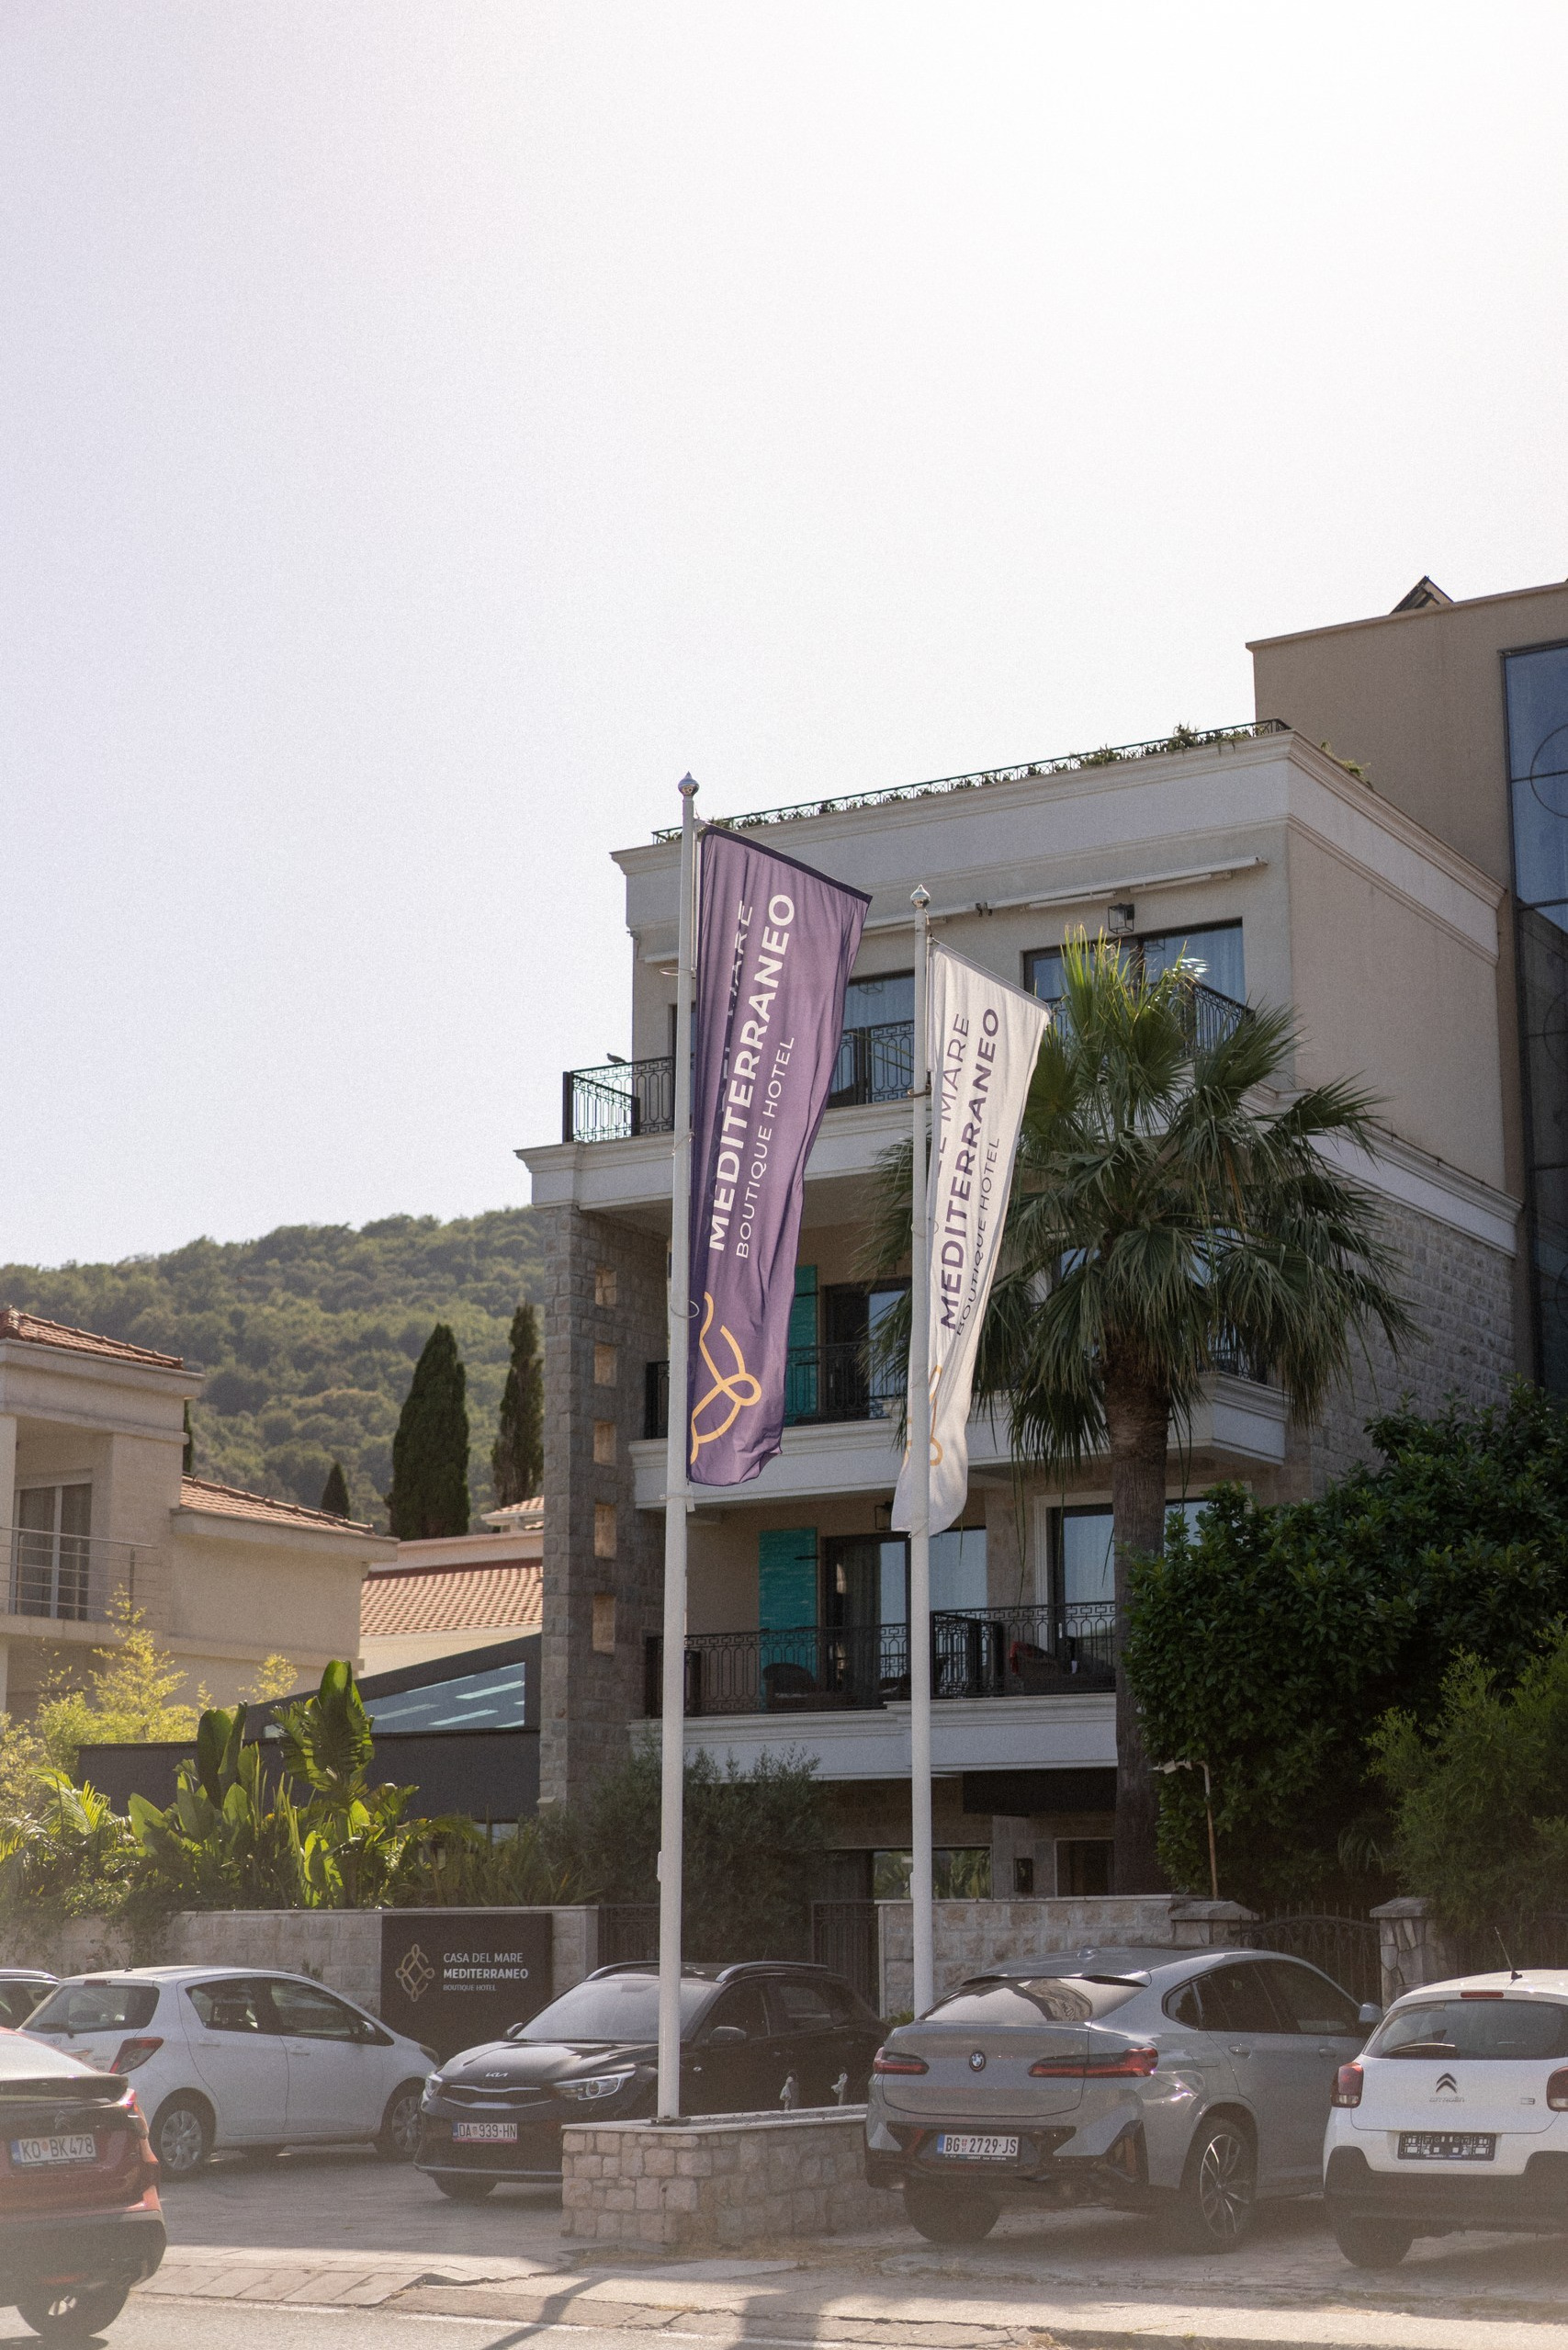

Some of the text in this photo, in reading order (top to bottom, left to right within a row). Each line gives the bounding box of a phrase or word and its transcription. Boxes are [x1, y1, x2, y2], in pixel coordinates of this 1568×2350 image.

[709, 894, 795, 1251] MEDITERRANEO
[941, 1013, 970, 1123] MARE
[736, 1037, 795, 1259] BOUTIQUE HOTEL
[940, 1008, 999, 1331] MEDITERRANEO
[956, 1137, 1000, 1337] BOUTIQUE HOTEL
[443, 1952, 524, 1963] CASA DEL MARE
[443, 1968, 529, 1980] MEDITERRANEO
[443, 1983, 497, 1992] BOUTIQUE HOTEL
[459, 2124, 472, 2138] DA
[21, 2141, 41, 2160] KO
[945, 2137, 961, 2152] BG
